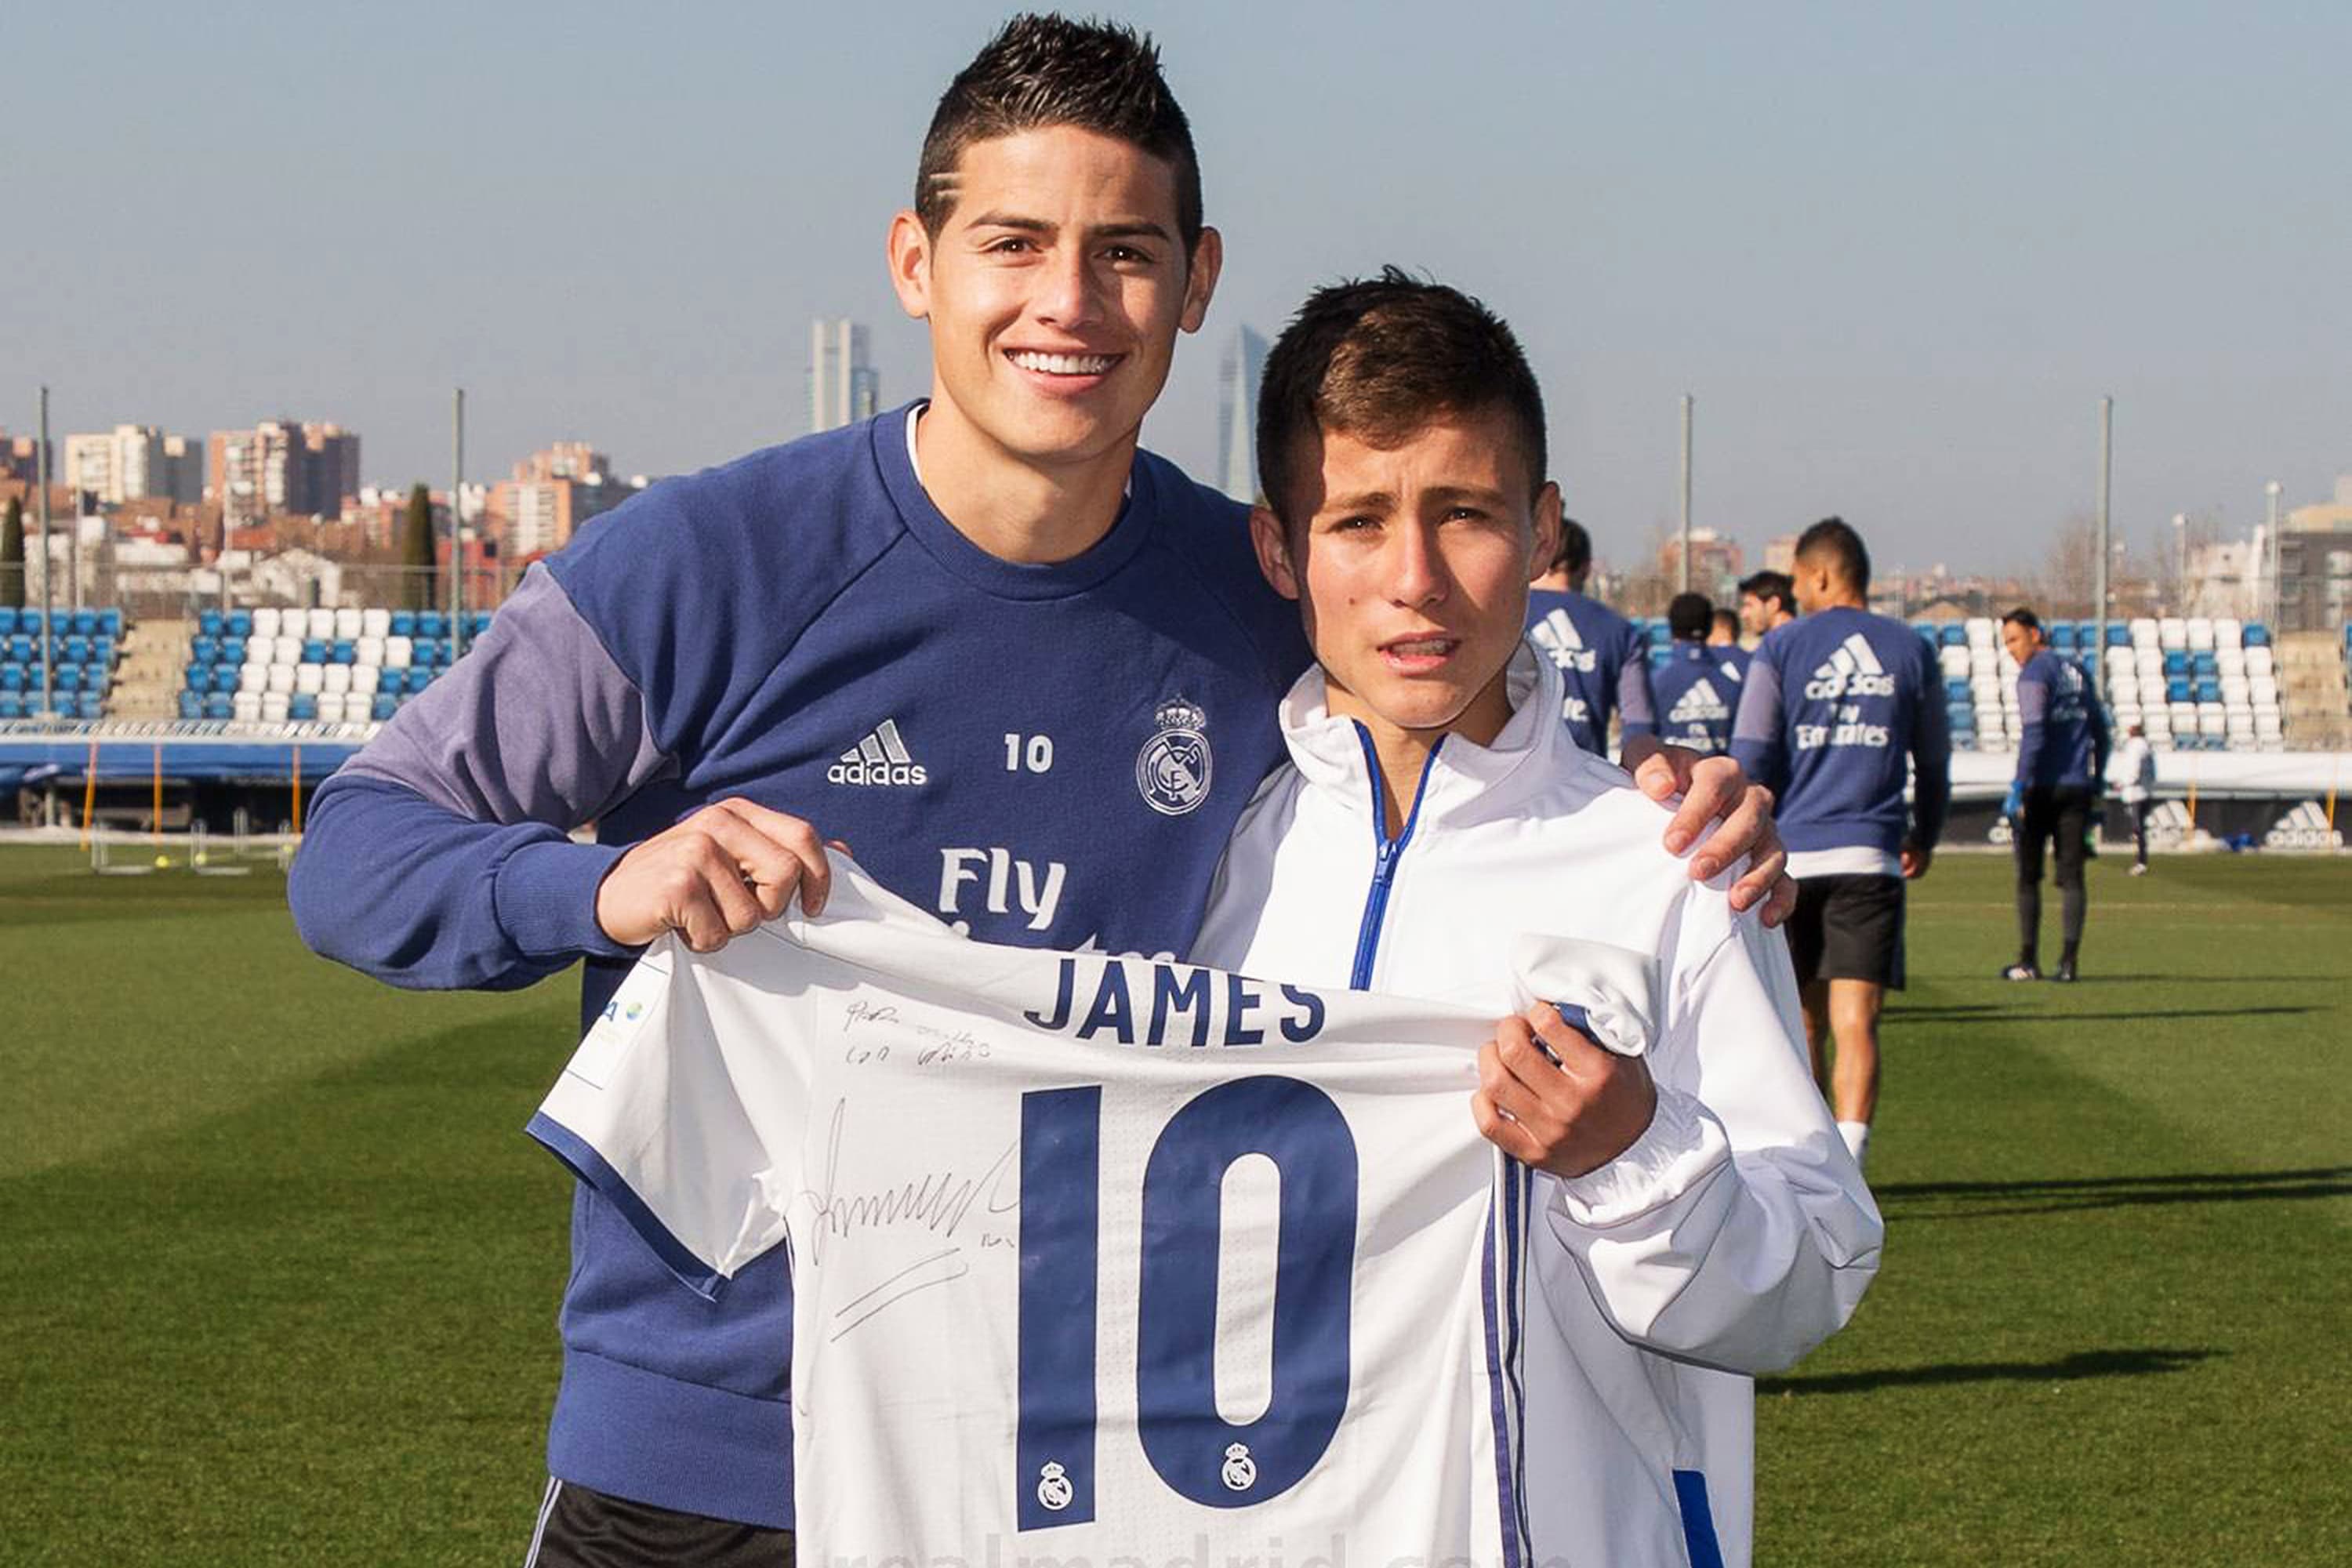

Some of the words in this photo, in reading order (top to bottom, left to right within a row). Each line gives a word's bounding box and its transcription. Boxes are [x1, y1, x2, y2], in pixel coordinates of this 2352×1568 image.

[1805, 673, 1895, 700] addas
[827, 760, 927, 786] adidas
[1004, 733, 1054, 773] 10
[938, 848, 1067, 931] Fly
[1023, 958, 1326, 1047] JAMES
[1018, 1074, 1358, 1533] 10
